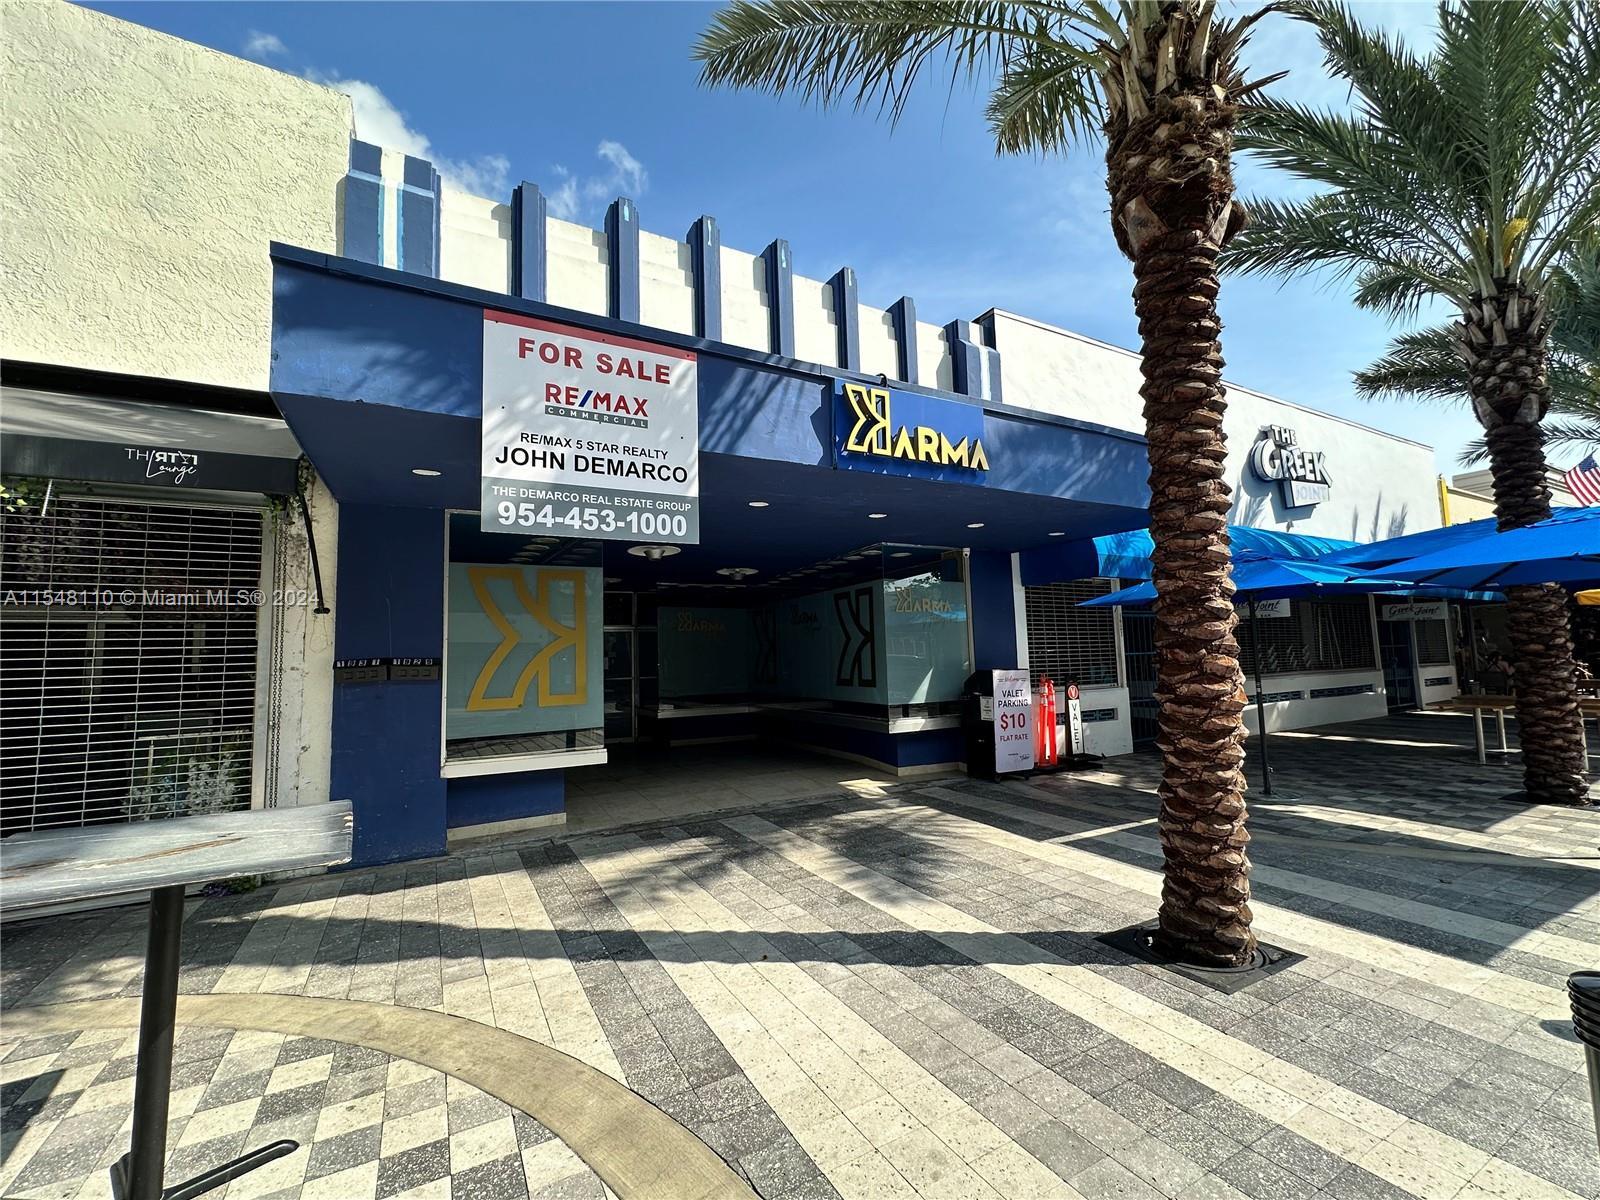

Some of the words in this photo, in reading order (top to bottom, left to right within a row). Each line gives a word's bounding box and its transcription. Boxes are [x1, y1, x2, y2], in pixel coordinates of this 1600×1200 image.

[519, 338, 583, 369] FOR
[596, 353, 671, 385] SALE
[545, 383, 648, 417] RE/MAX
[547, 407, 647, 427] COMMERCIAL
[521, 432, 572, 449] RE/MAX
[575, 440, 583, 450] 5
[587, 441, 619, 454] STAR
[623, 446, 669, 460] REALTY
[1270, 424, 1298, 447] THE
[146, 450, 197, 484] Lounge
[495, 446, 565, 470] JOHN
[574, 455, 688, 483] DEMARCO
[1253, 437, 1333, 488] GREEK
[491, 485, 517, 497] THE
[520, 488, 579, 502] DEMARCO
[582, 494, 612, 505] REAL
[615, 497, 653, 509] ESTATE
[656, 501, 692, 512] GROUP
[1295, 484, 1327, 500] JOINT
[498, 502, 687, 536] 954-453-1000
[997, 698, 1029, 708] PARKING
[1002, 689, 1024, 698] VALET
[1000, 712, 1026, 731] $10
[1071, 703, 1080, 751] VALET
[1000, 734, 1014, 742] FLAT
[1014, 733, 1029, 741] RATE
